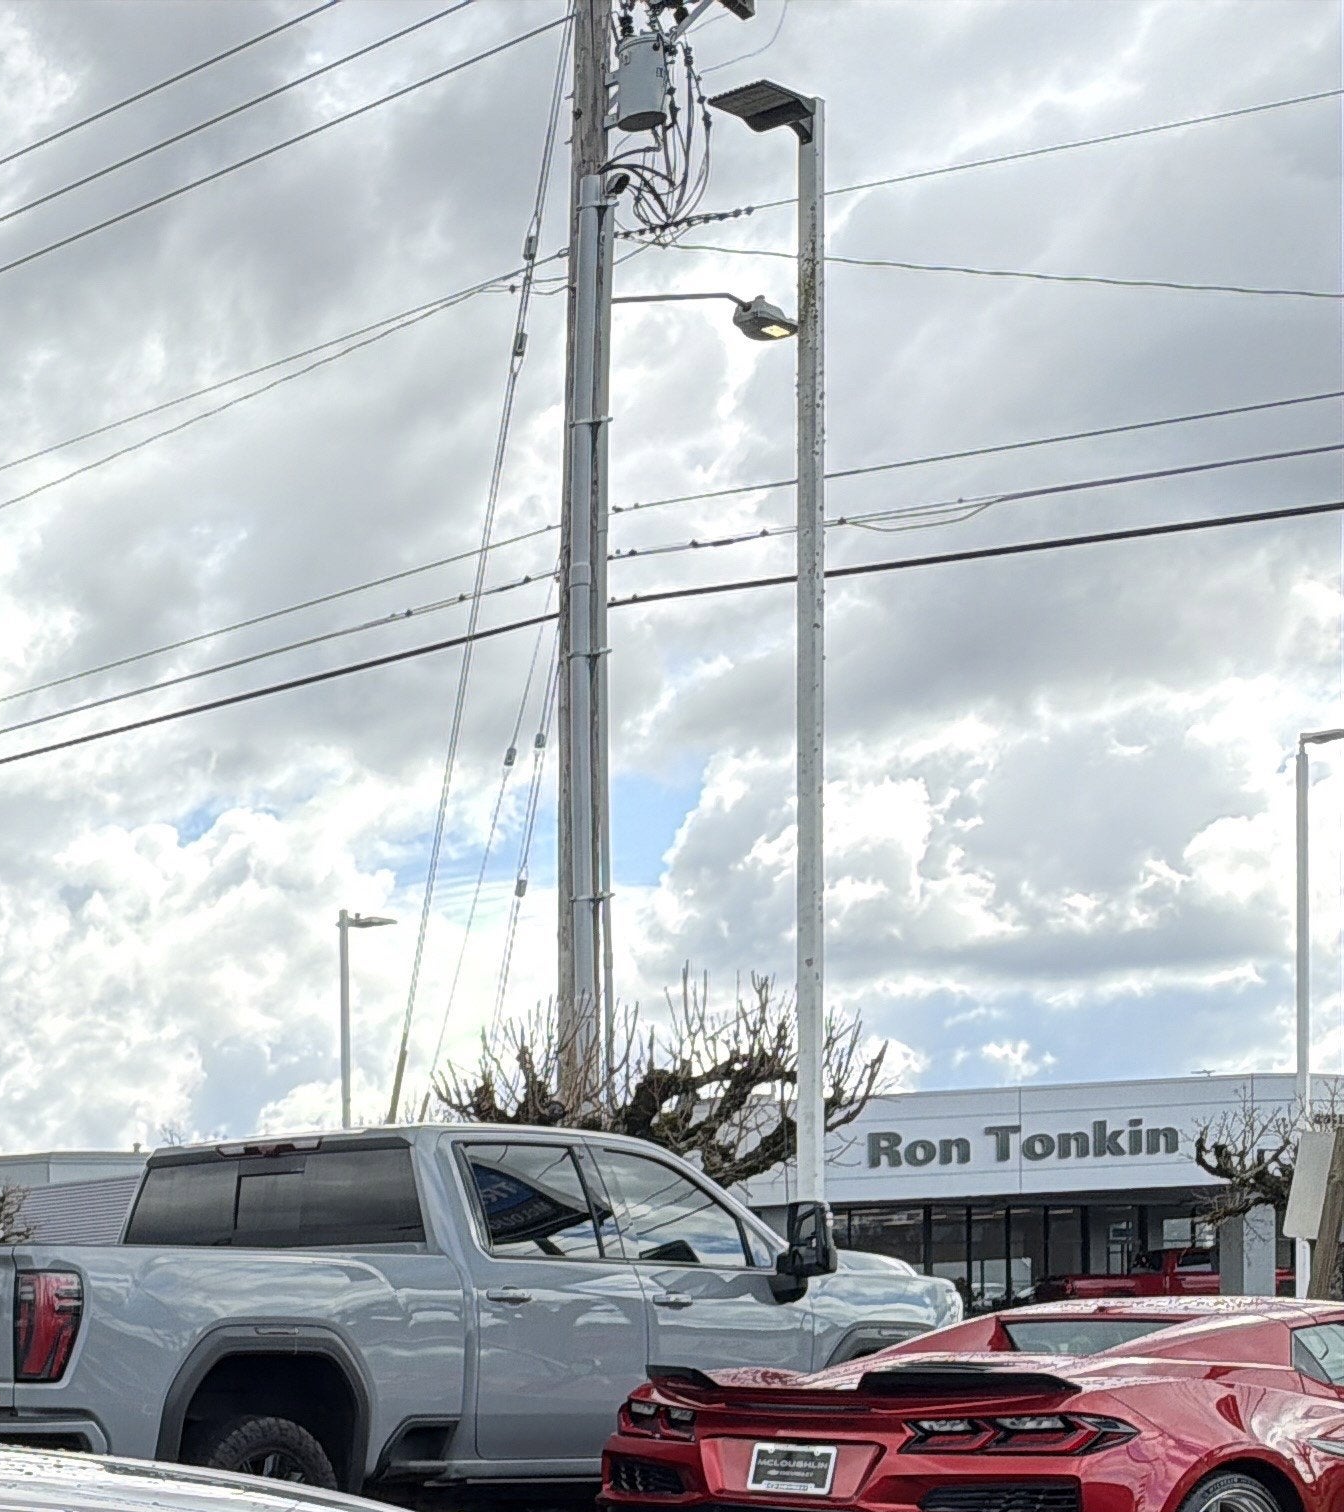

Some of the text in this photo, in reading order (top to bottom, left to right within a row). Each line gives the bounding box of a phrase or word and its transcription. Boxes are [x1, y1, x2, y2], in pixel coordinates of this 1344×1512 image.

[867, 1118, 1180, 1169] Ron Tonkin
[756, 1458, 829, 1469] MCLOUGHLIN
